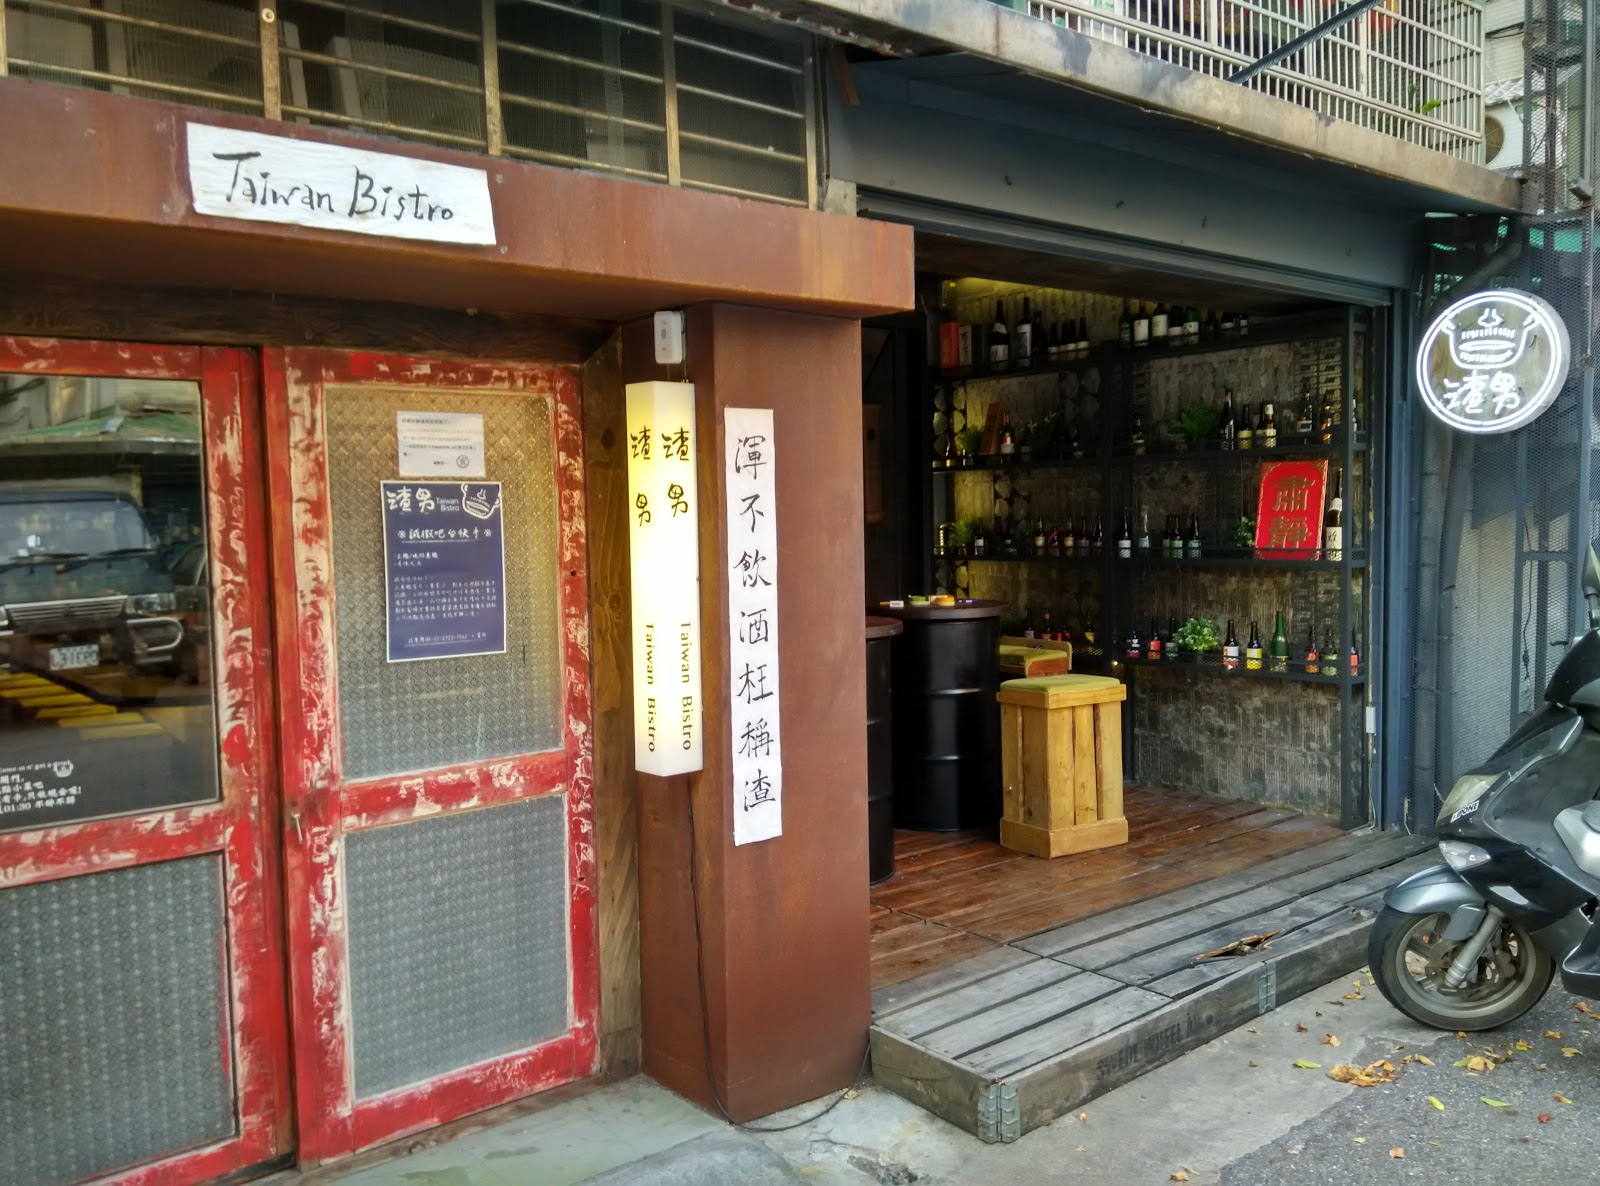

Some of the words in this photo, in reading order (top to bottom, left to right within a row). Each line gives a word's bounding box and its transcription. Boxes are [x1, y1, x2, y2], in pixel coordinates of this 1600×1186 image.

[212, 151, 335, 213] Taiwan
[348, 164, 454, 221] Bistro
[1443, 369, 1520, 415] 渣男
[386, 486, 435, 513] 渣男
[630, 425, 652, 527] 渣男
[661, 427, 690, 517] 渣男
[440, 504, 460, 512] Bistro
[647, 698, 657, 752] Bistro
[682, 695, 694, 751] Bistro
